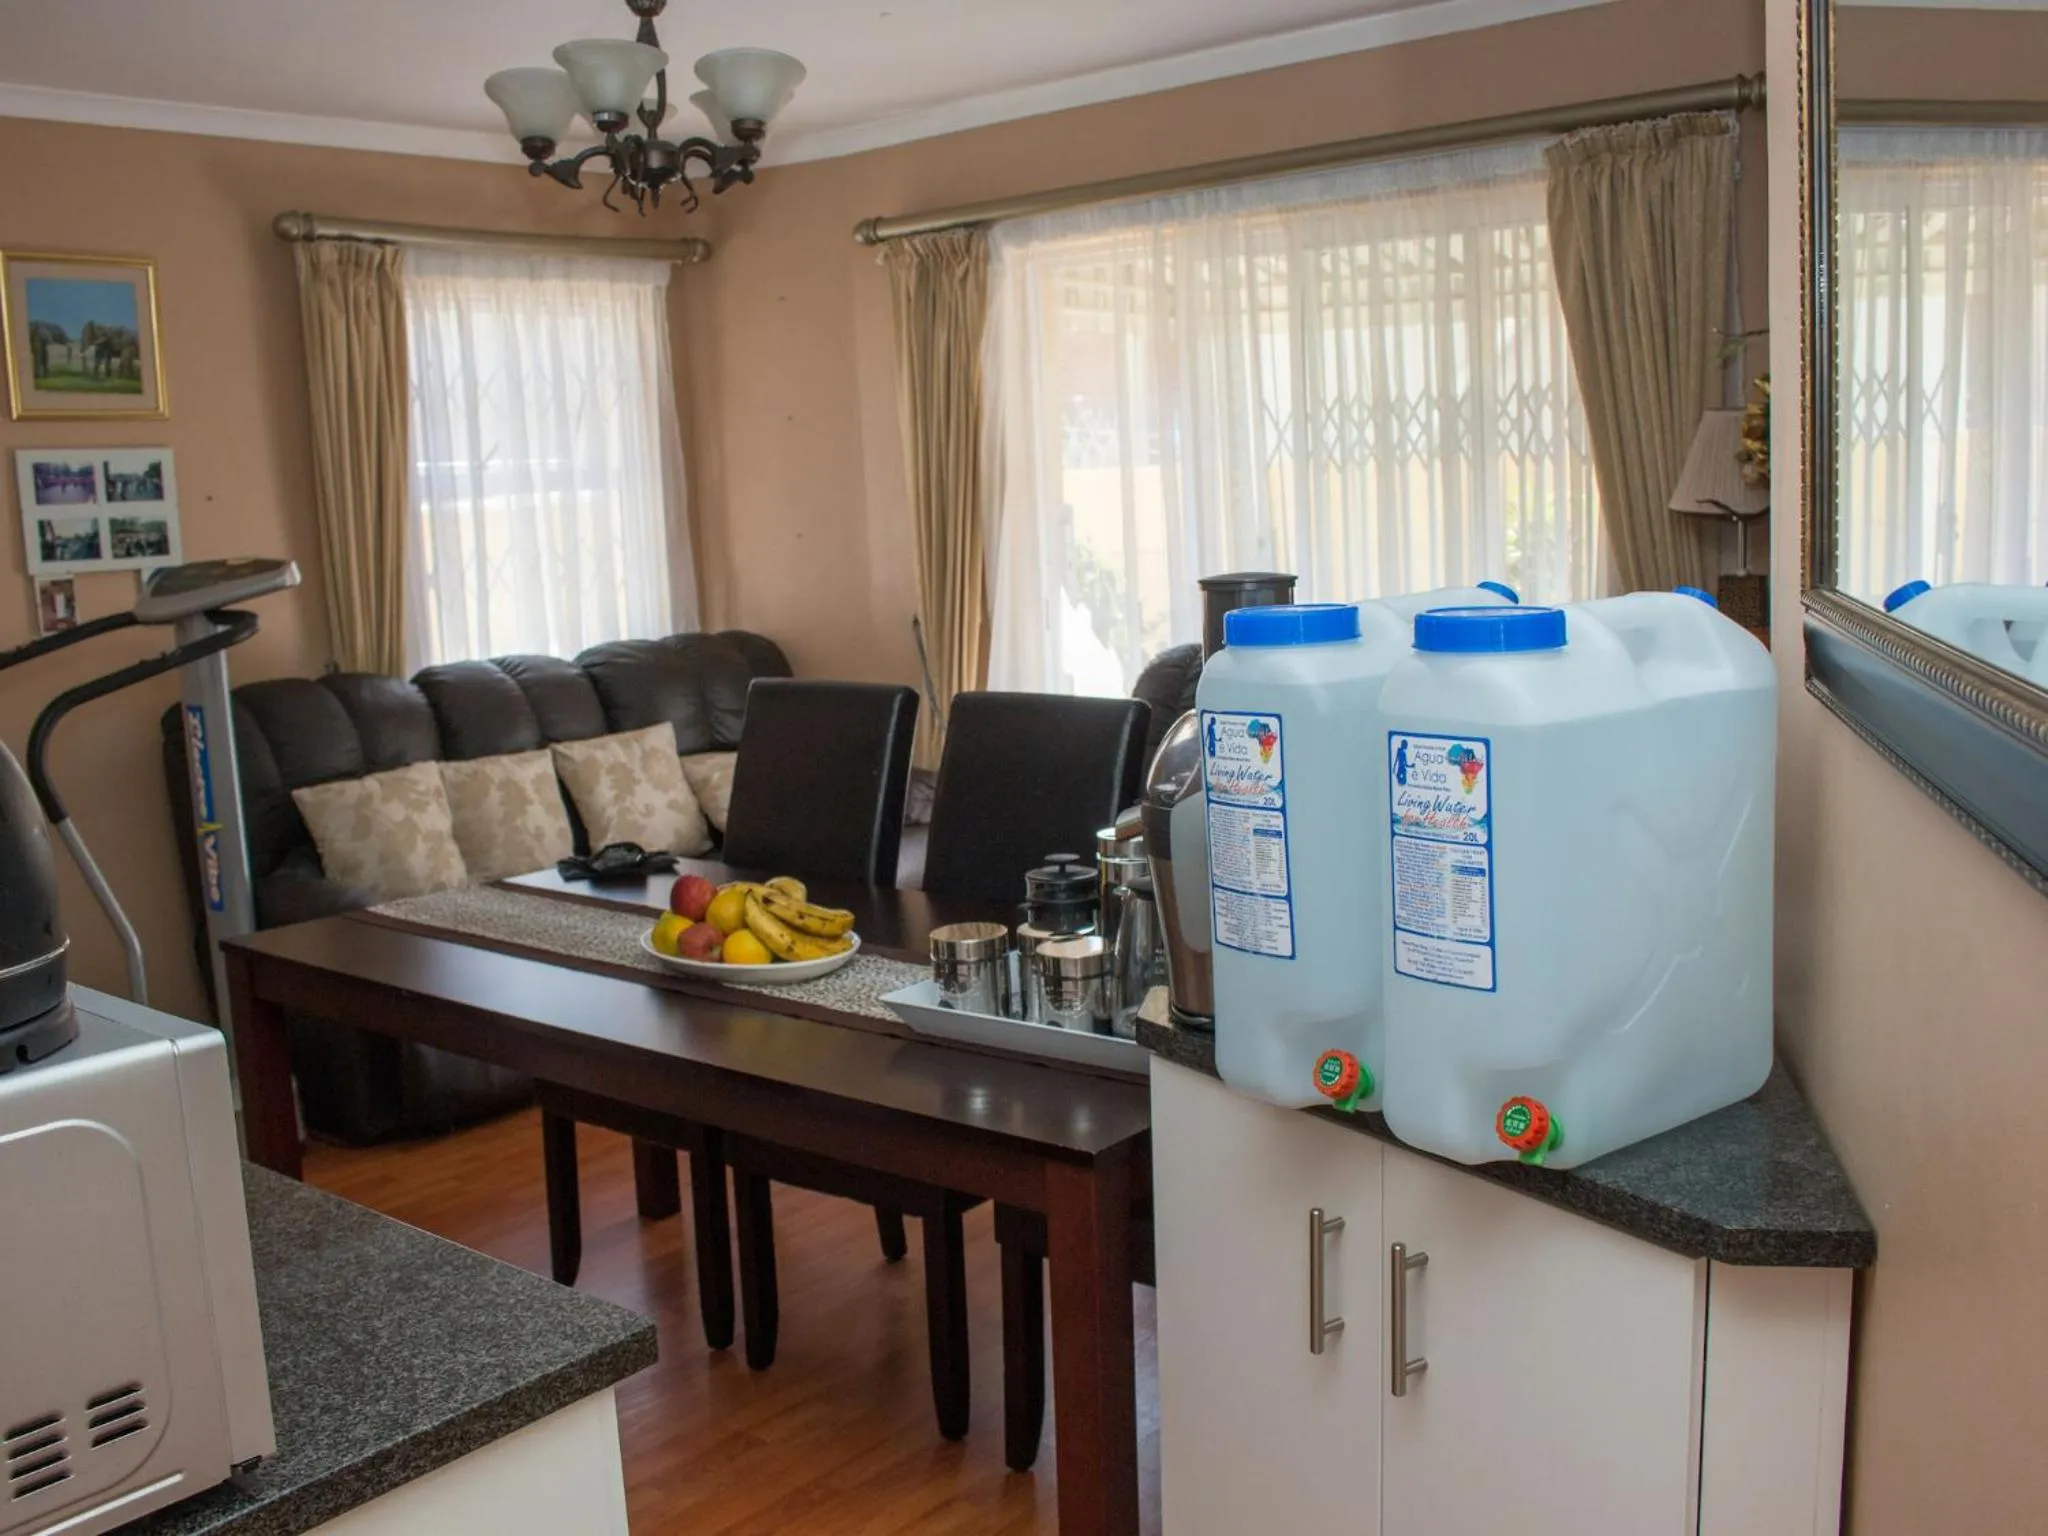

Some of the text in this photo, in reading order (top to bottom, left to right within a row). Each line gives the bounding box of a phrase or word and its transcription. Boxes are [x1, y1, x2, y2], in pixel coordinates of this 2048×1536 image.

[1221, 726, 1245, 740] Agua
[1226, 742, 1248, 755] Vida
[1414, 751, 1444, 766] Agua
[1209, 760, 1273, 782] Living Water
[1421, 770, 1447, 784] Vida
[1397, 790, 1477, 815] Living Water
[1424, 810, 1468, 830] Health
[1463, 832, 1479, 842] 20L
